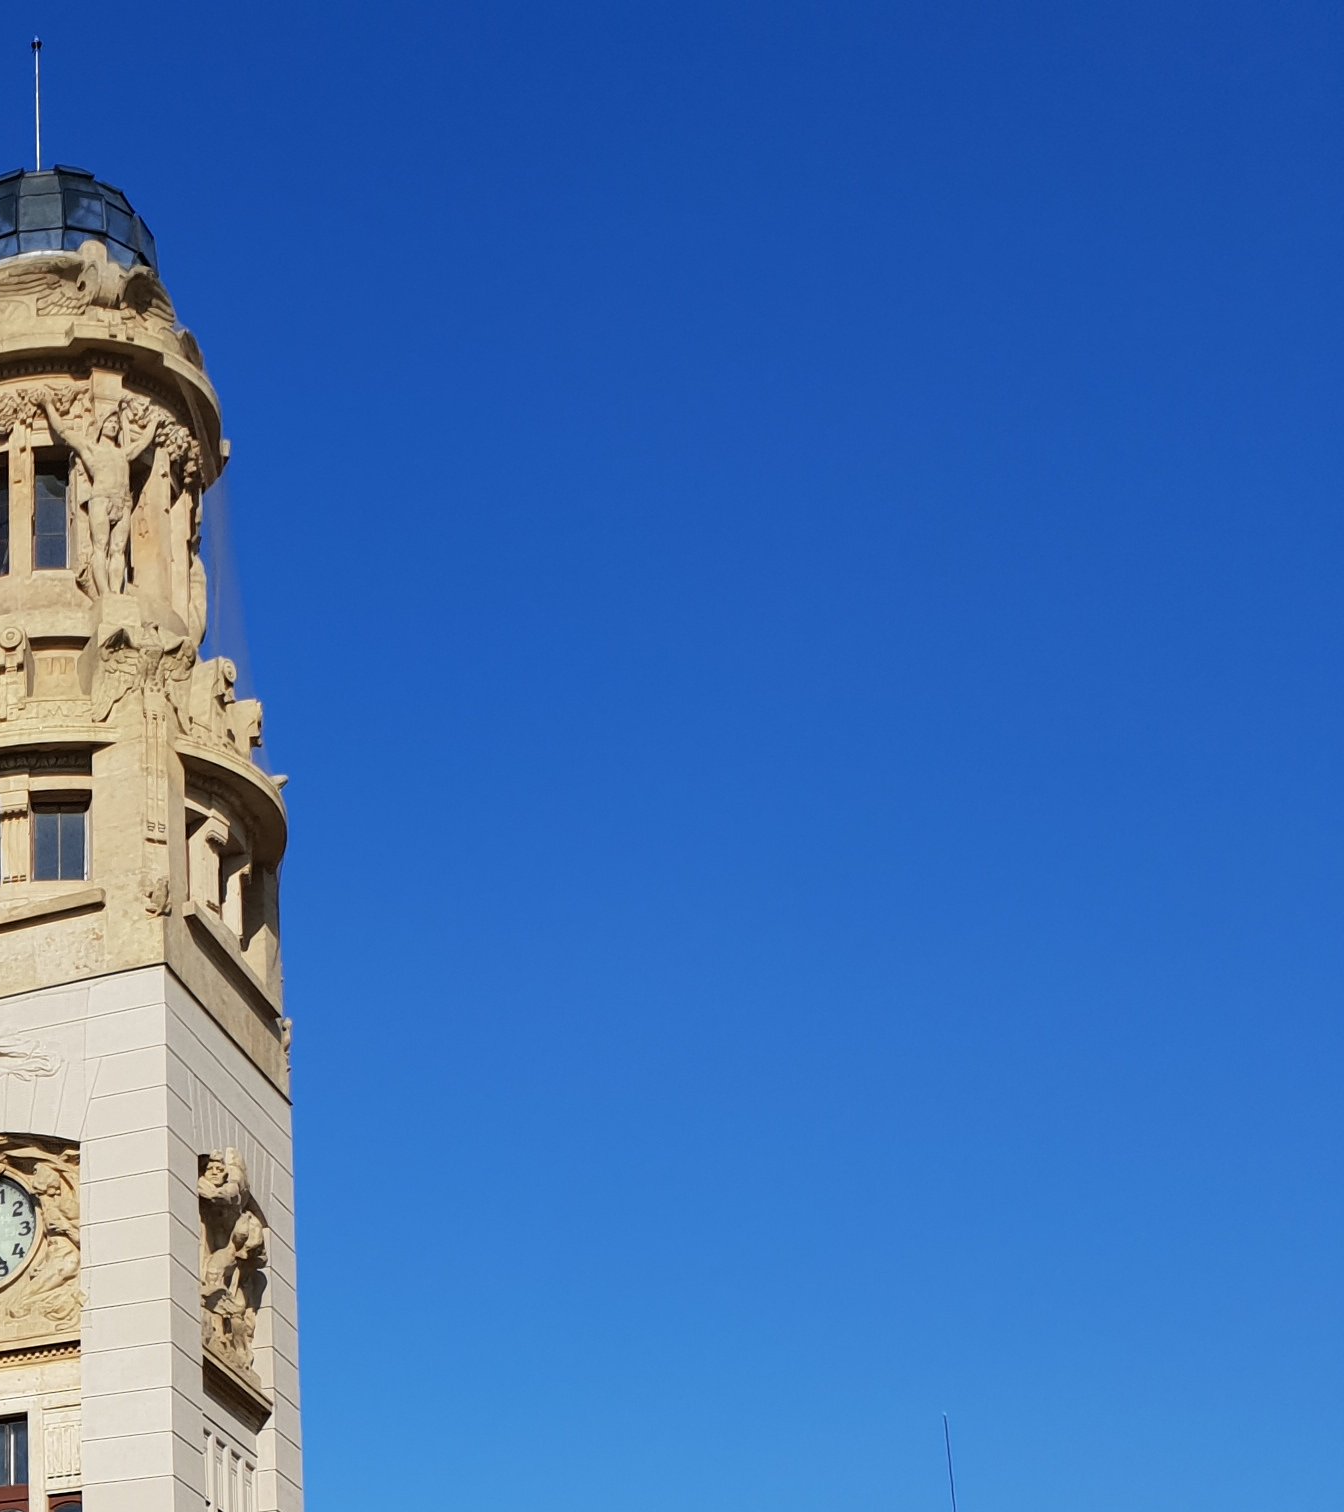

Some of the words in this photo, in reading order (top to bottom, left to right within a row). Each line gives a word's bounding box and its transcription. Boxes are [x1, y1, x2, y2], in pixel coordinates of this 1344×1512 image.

[12, 1200, 24, 1217] 2
[18, 1220, 32, 1236] 3
[11, 1243, 25, 1258] 4
